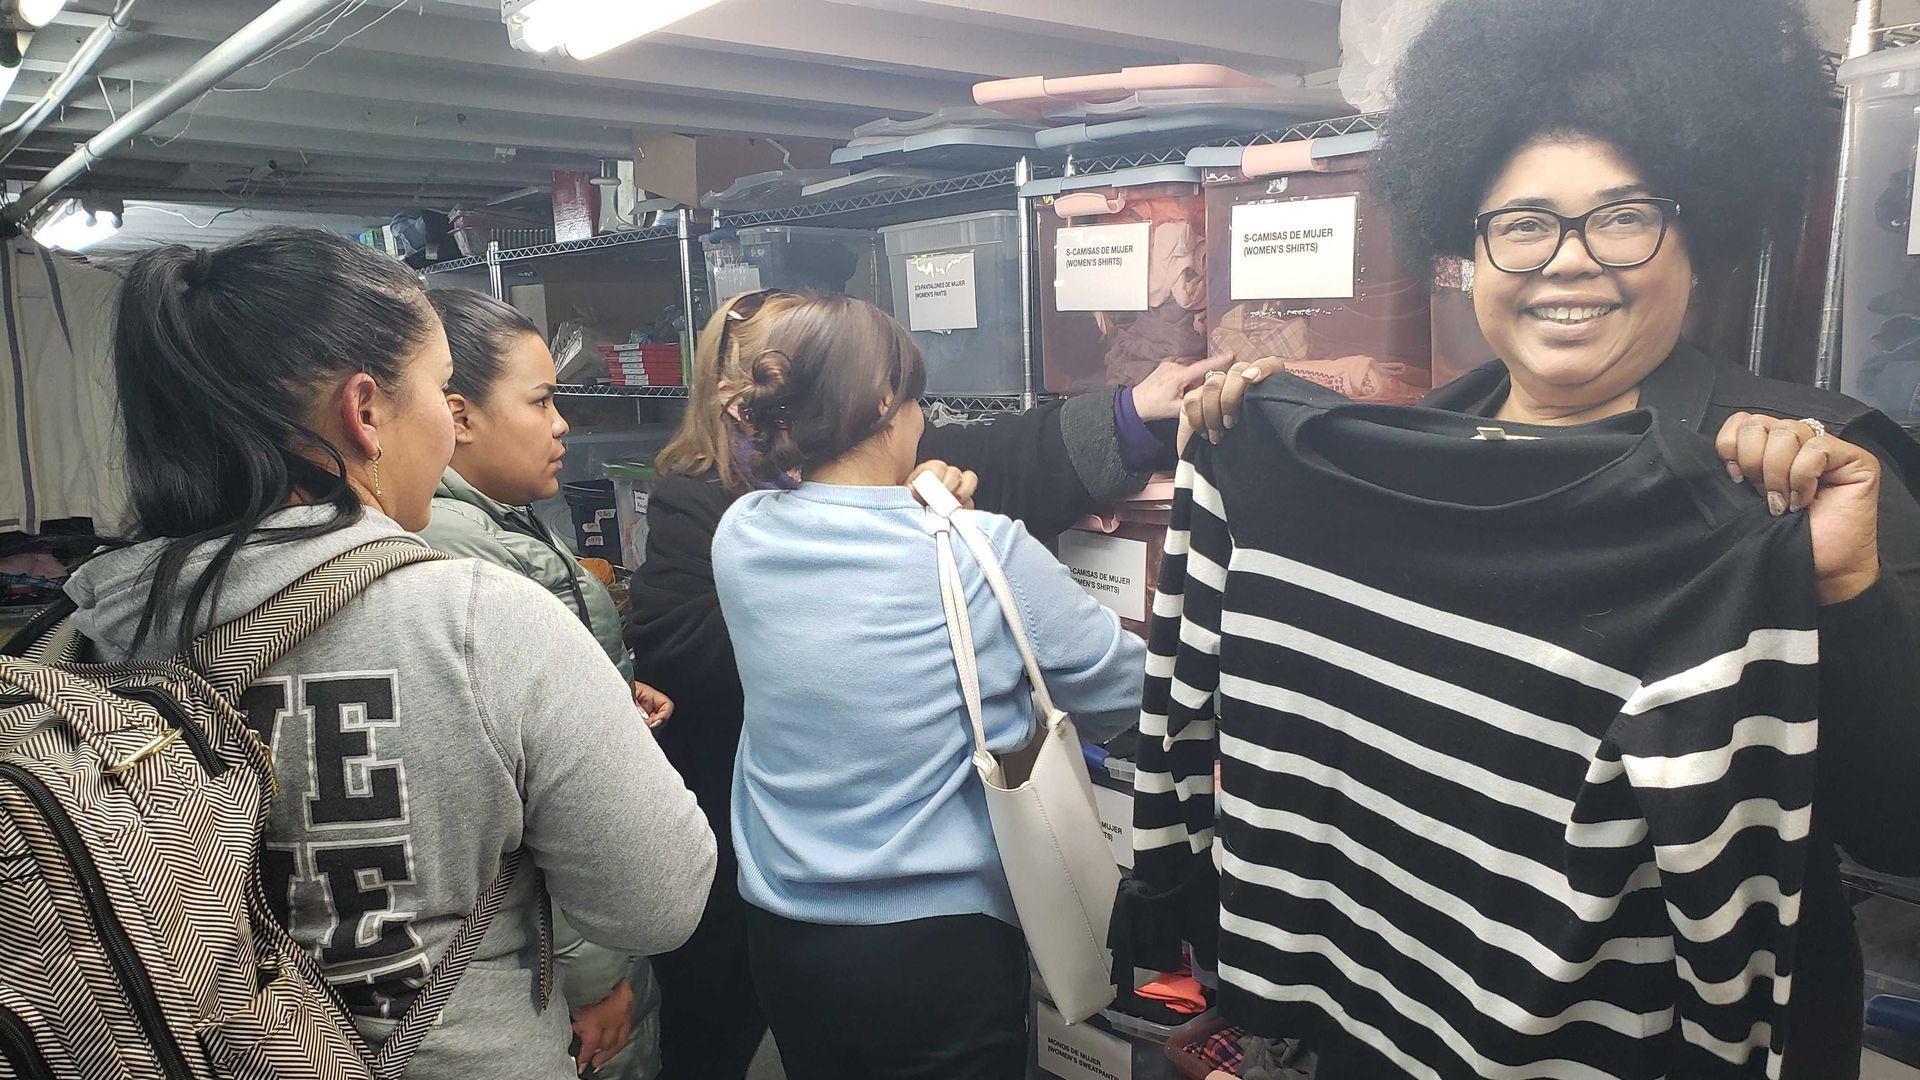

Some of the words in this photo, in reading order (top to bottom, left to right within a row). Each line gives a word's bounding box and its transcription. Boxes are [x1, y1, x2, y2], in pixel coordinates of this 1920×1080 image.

[1243, 231, 1288, 243] S-CAMISAS
[1289, 230, 1301, 240] DE
[1303, 228, 1334, 239] MUJER
[1066, 246, 1100, 256] S-CAMISAS
[1101, 246, 1110, 255] DE
[1111, 245, 1133, 254] MUJER
[1243, 244, 1284, 257] (WOMEN'S
[1285, 242, 1319, 254] SHIRTS)
[1065, 258, 1097, 269] (WOMEN'S
[1097, 257, 1122, 267] SHIRTS)
[1069, 567, 1098, 579] -CAMISAS
[1099, 572, 1108, 581] DE
[1108, 575, 1131, 586] MUJER
[1072, 577, 1096, 589] OMEN'S
[1096, 582, 1120, 595] SHIRTS)
[1101, 821, 1123, 835] MUJER
[1047, 1036, 1070, 1052] MONOS
[1070, 1046, 1079, 1057] DE
[1080, 1051, 1102, 1067] MUJER
[1047, 1045, 1078, 1064] (WOMEN'S
